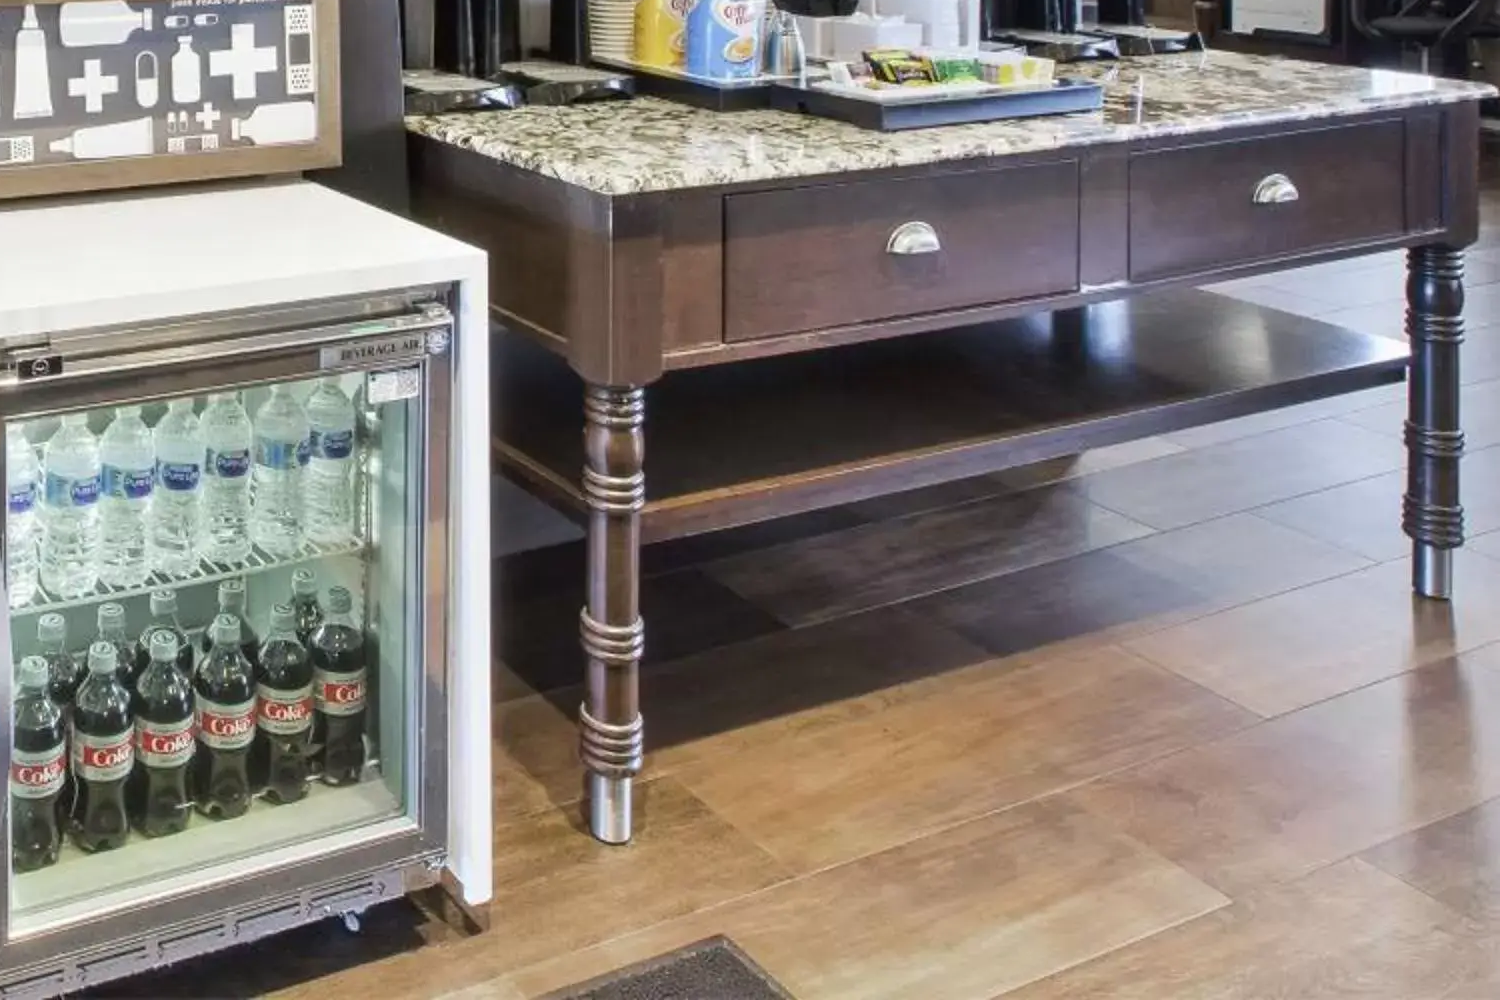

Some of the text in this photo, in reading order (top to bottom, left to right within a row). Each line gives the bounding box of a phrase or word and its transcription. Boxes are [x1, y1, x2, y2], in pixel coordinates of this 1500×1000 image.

[264, 702, 306, 721] Coke
[211, 717, 251, 736] Coke
[152, 731, 192, 753] Coke
[19, 761, 61, 784] Coke
